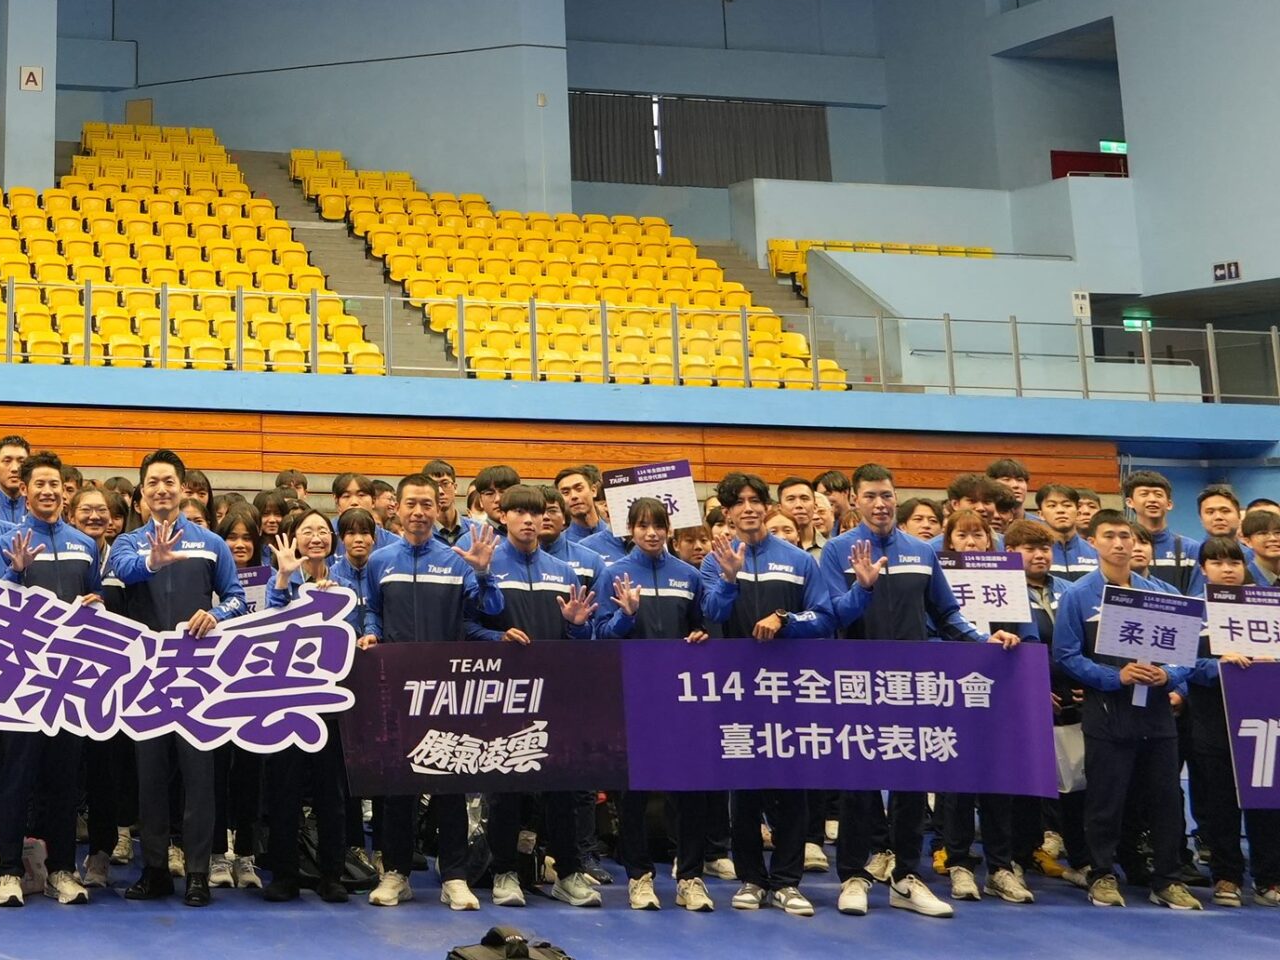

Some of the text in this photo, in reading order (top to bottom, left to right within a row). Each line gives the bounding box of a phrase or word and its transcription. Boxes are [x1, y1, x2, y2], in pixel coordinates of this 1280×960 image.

[24, 71, 38, 86] A
[428, 564, 453, 574] TAIPEI
[768, 562, 793, 573] TAIPEI
[951, 583, 1008, 607] 手球
[1118, 620, 1178, 650] 柔道
[449, 658, 502, 673] TEAM
[403, 677, 545, 716] TAIPEI
[677, 668, 995, 708] 114 年全國運動會
[406, 720, 549, 775] 勝氣凌雲
[719, 722, 958, 762] 臺北市代表隊
